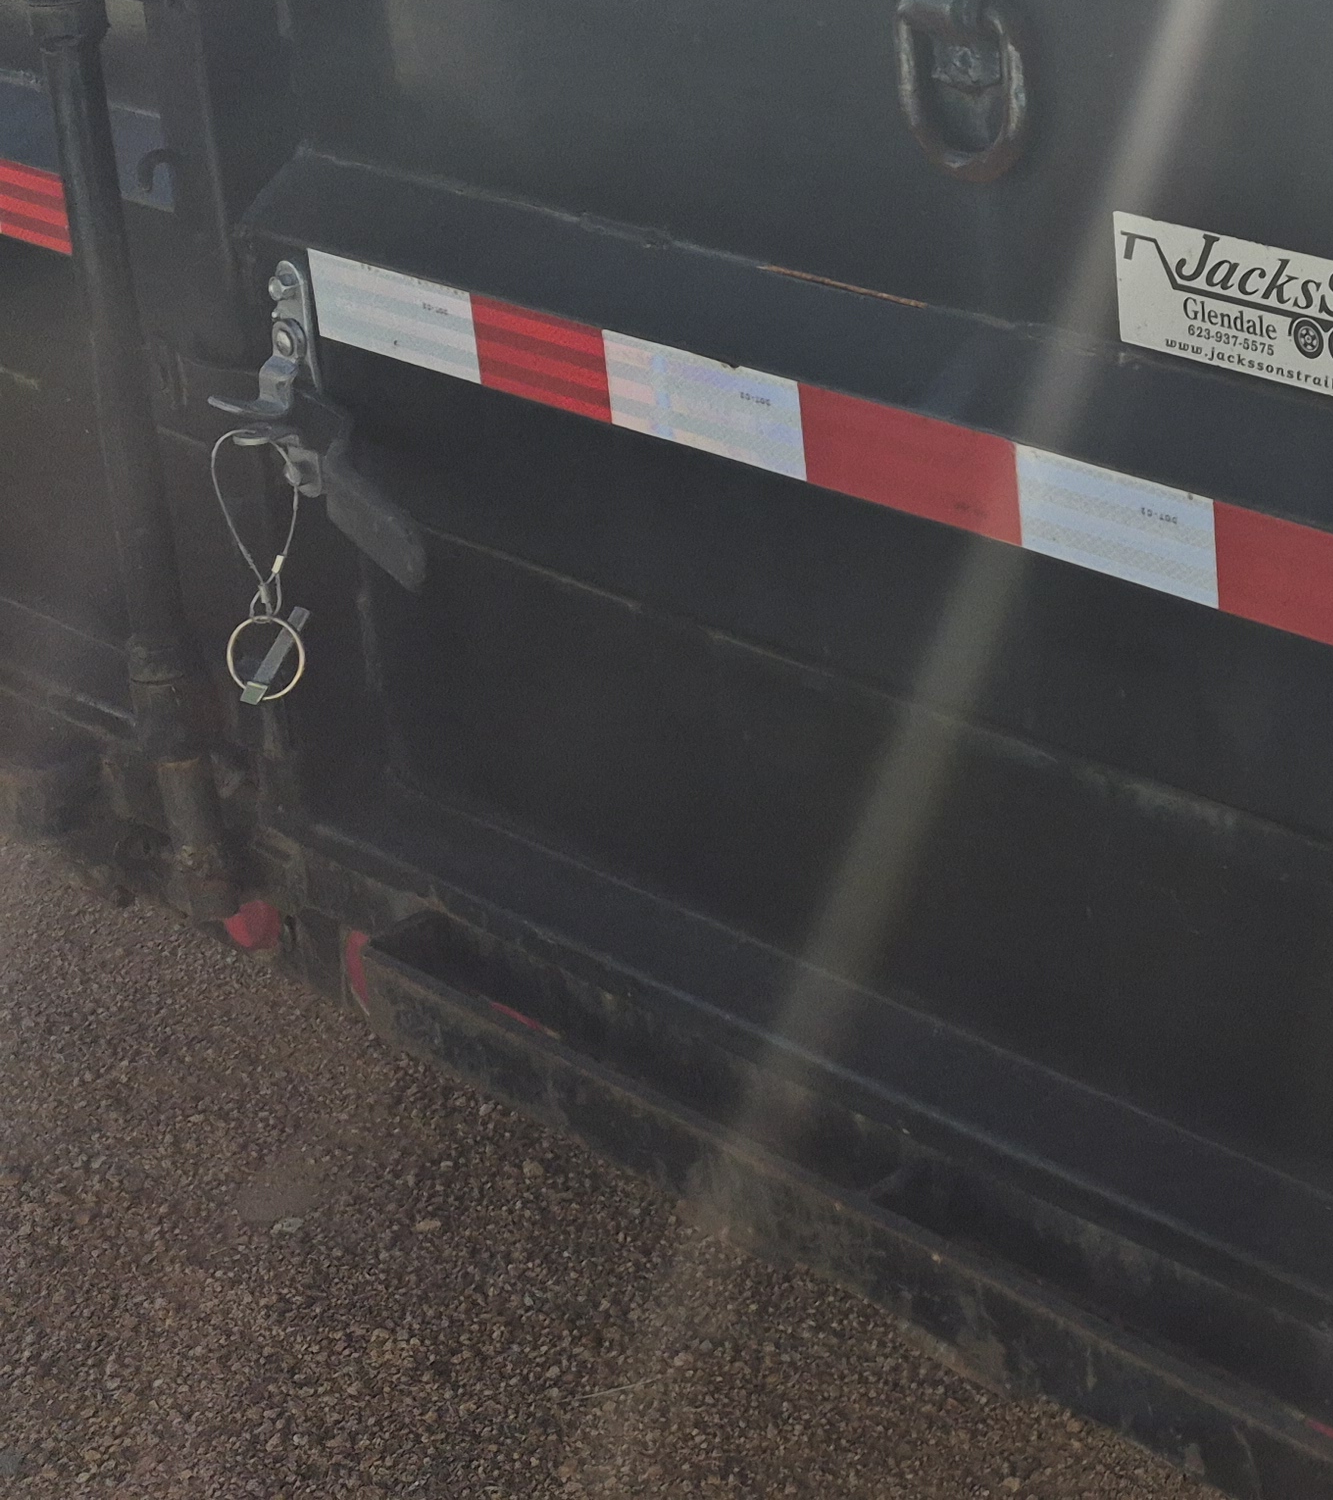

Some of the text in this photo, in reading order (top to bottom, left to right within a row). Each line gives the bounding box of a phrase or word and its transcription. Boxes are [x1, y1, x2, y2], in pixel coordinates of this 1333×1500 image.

[1183, 296, 1278, 341] Glendale
[1188, 324, 1275, 357] 623-937-5575
[1141, 507, 1178, 525] DOT-C2
